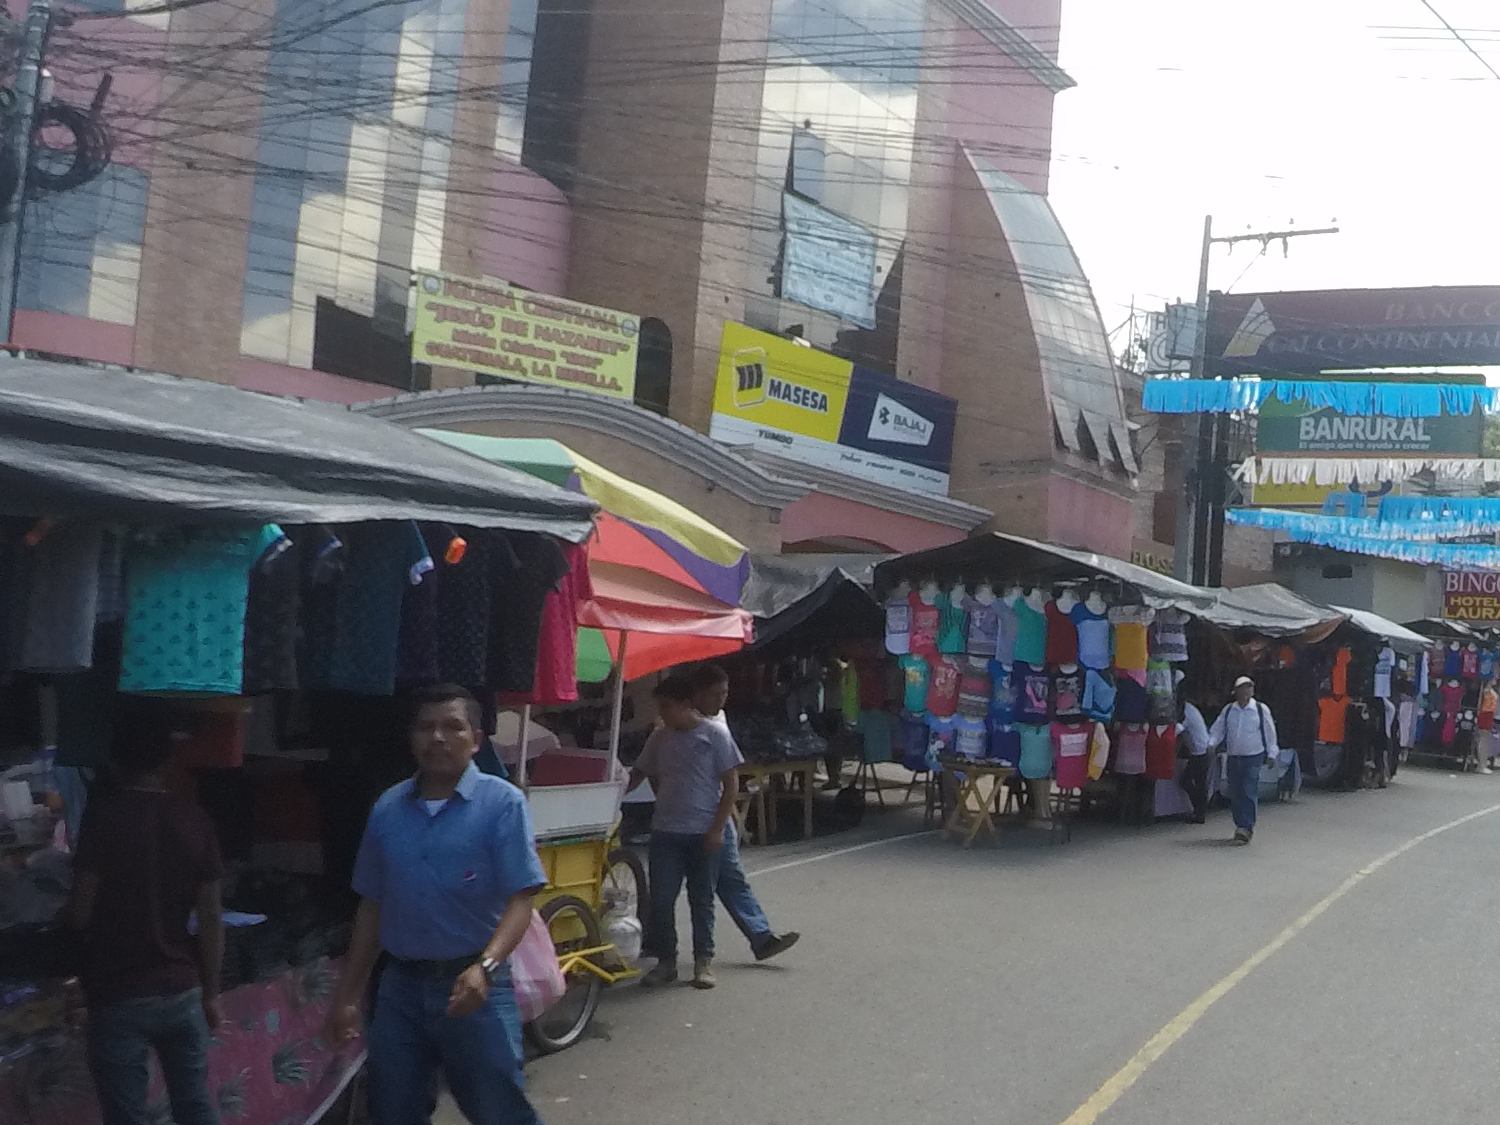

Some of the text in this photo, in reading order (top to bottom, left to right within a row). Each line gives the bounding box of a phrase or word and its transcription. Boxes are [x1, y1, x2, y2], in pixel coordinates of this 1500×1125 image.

[767, 378, 829, 412] MASESA
[893, 415, 927, 433] BAJAJ
[1300, 417, 1431, 441] BANRURAL
